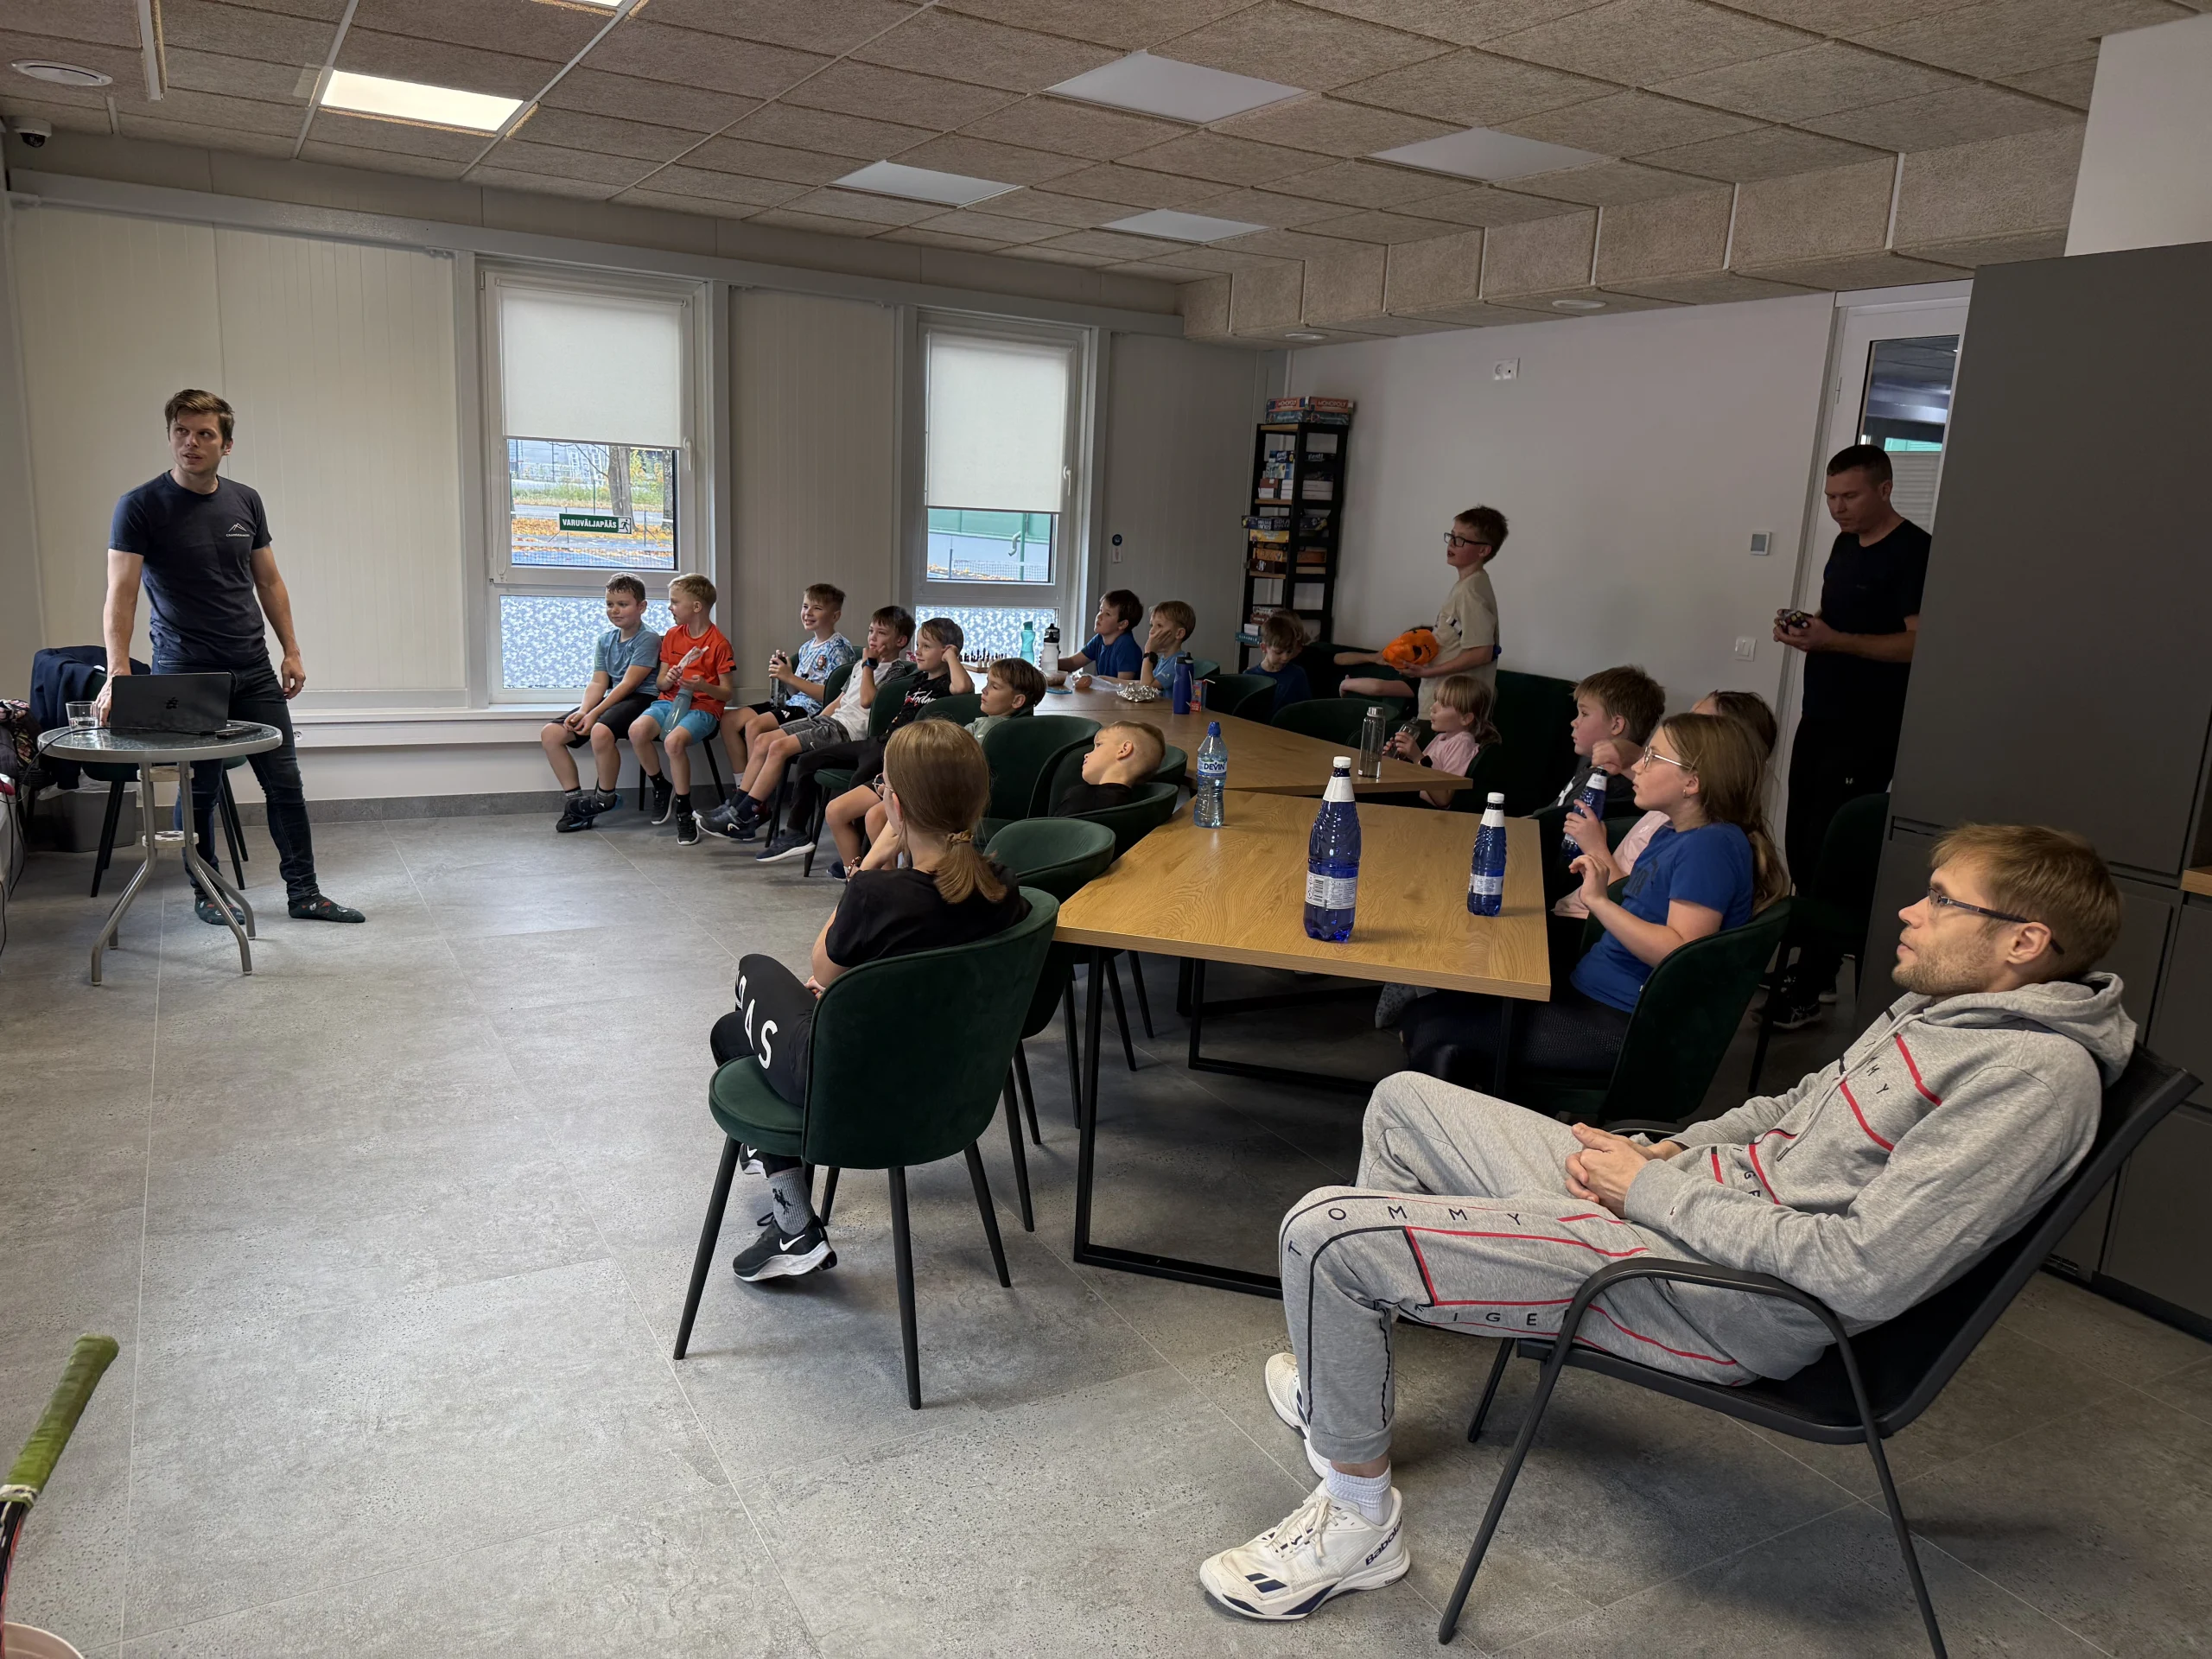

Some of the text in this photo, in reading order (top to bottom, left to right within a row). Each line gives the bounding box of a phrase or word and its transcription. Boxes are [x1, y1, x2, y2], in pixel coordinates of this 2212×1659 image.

[562, 518, 617, 529] VARUVÄLJAPÄÄS
[1204, 762, 1225, 771] DEVIN
[1287, 1205, 1522, 1257] TOMMY
[1365, 1516, 1403, 1567] Babola
